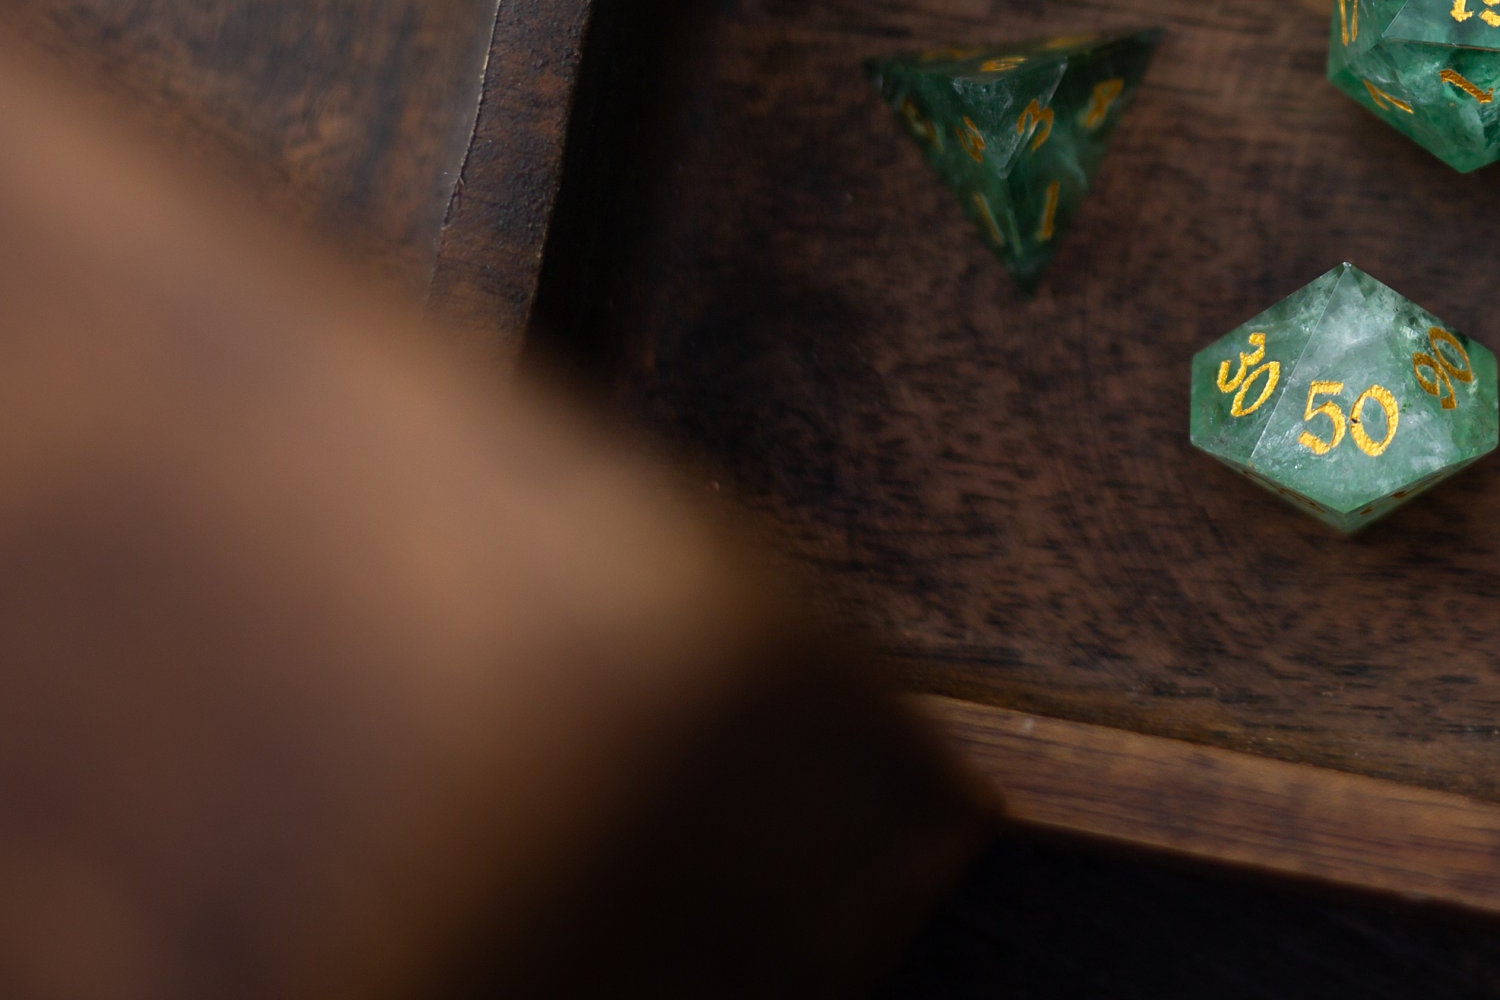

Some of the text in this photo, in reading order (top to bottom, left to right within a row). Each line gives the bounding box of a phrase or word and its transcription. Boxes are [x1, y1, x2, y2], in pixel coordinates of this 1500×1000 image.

[1439, 69, 1494, 104] 1
[1216, 332, 1281, 418] 30
[1298, 380, 1400, 457] 50
